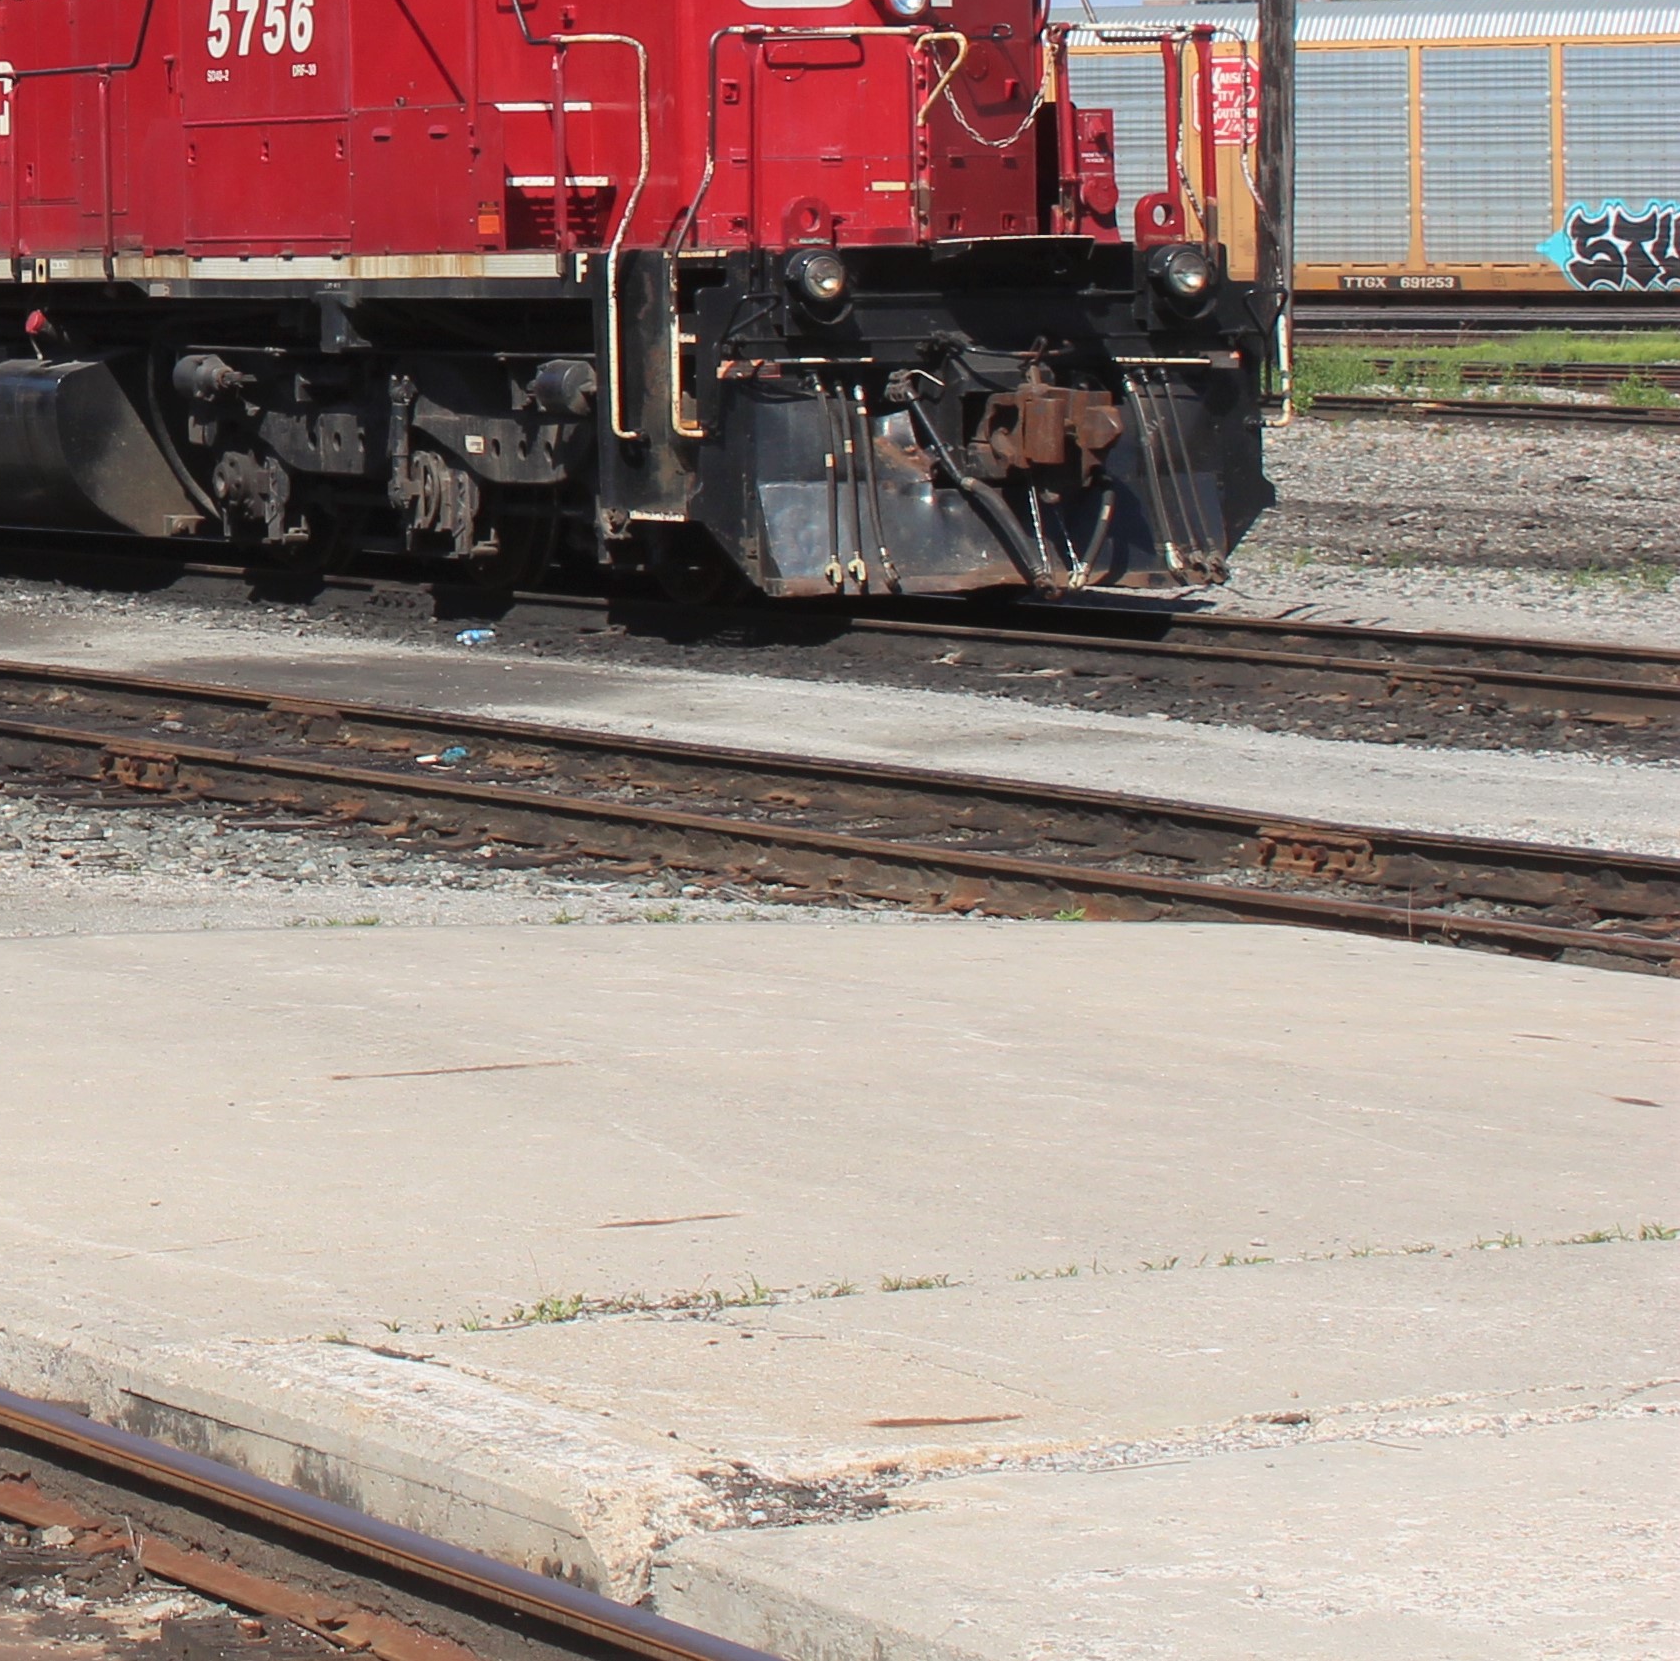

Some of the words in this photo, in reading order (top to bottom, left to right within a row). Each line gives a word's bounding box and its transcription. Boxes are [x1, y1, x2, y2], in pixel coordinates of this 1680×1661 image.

[575, 252, 589, 283] F
[1344, 276, 1387, 289] TTGX
[1399, 276, 1455, 289] 691253
